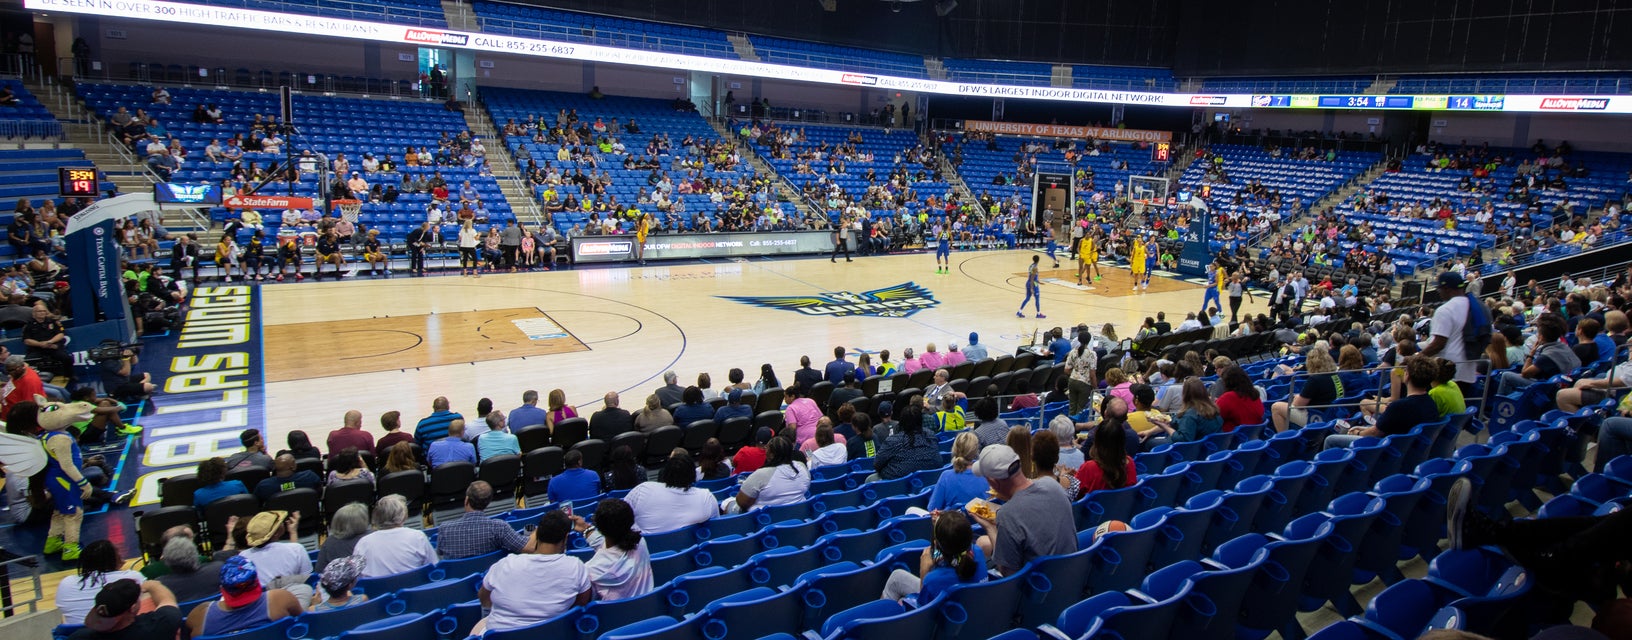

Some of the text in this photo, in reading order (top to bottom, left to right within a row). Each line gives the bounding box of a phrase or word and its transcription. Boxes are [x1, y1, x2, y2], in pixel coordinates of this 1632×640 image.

[100, 0, 112, 9] IN
[116, 1, 150, 13] OVER
[154, 5, 176, 15] 300
[179, 7, 210, 18] HIGH
[214, 10, 260, 23] TRAFFIC
[263, 15, 292, 24] BARS
[305, 20, 379, 33] RESTAURANTS
[475, 37, 504, 49] CALL:
[506, 41, 575, 55] 855-255-6837
[958, 84, 1164, 103] DFW'S LARGEST INDOOR DIGITAL NETWORK!
[1276, 97, 1283, 106] 7
[1347, 96, 1369, 106] 3:54
[1455, 97, 1469, 108] 14
[976, 121, 1161, 141] UNIVERSITY OF TEXAS AT ARLINGTON
[1157, 150, 1167, 160] 19
[70, 170, 95, 180] 3:54
[74, 180, 90, 191] 19
[74, 204, 99, 221] SPALDING
[95, 236, 108, 298] TEXAS CAPITAL BANK
[798, 297, 937, 315] WINGS
[129, 285, 251, 507] DALLAS WINGS
